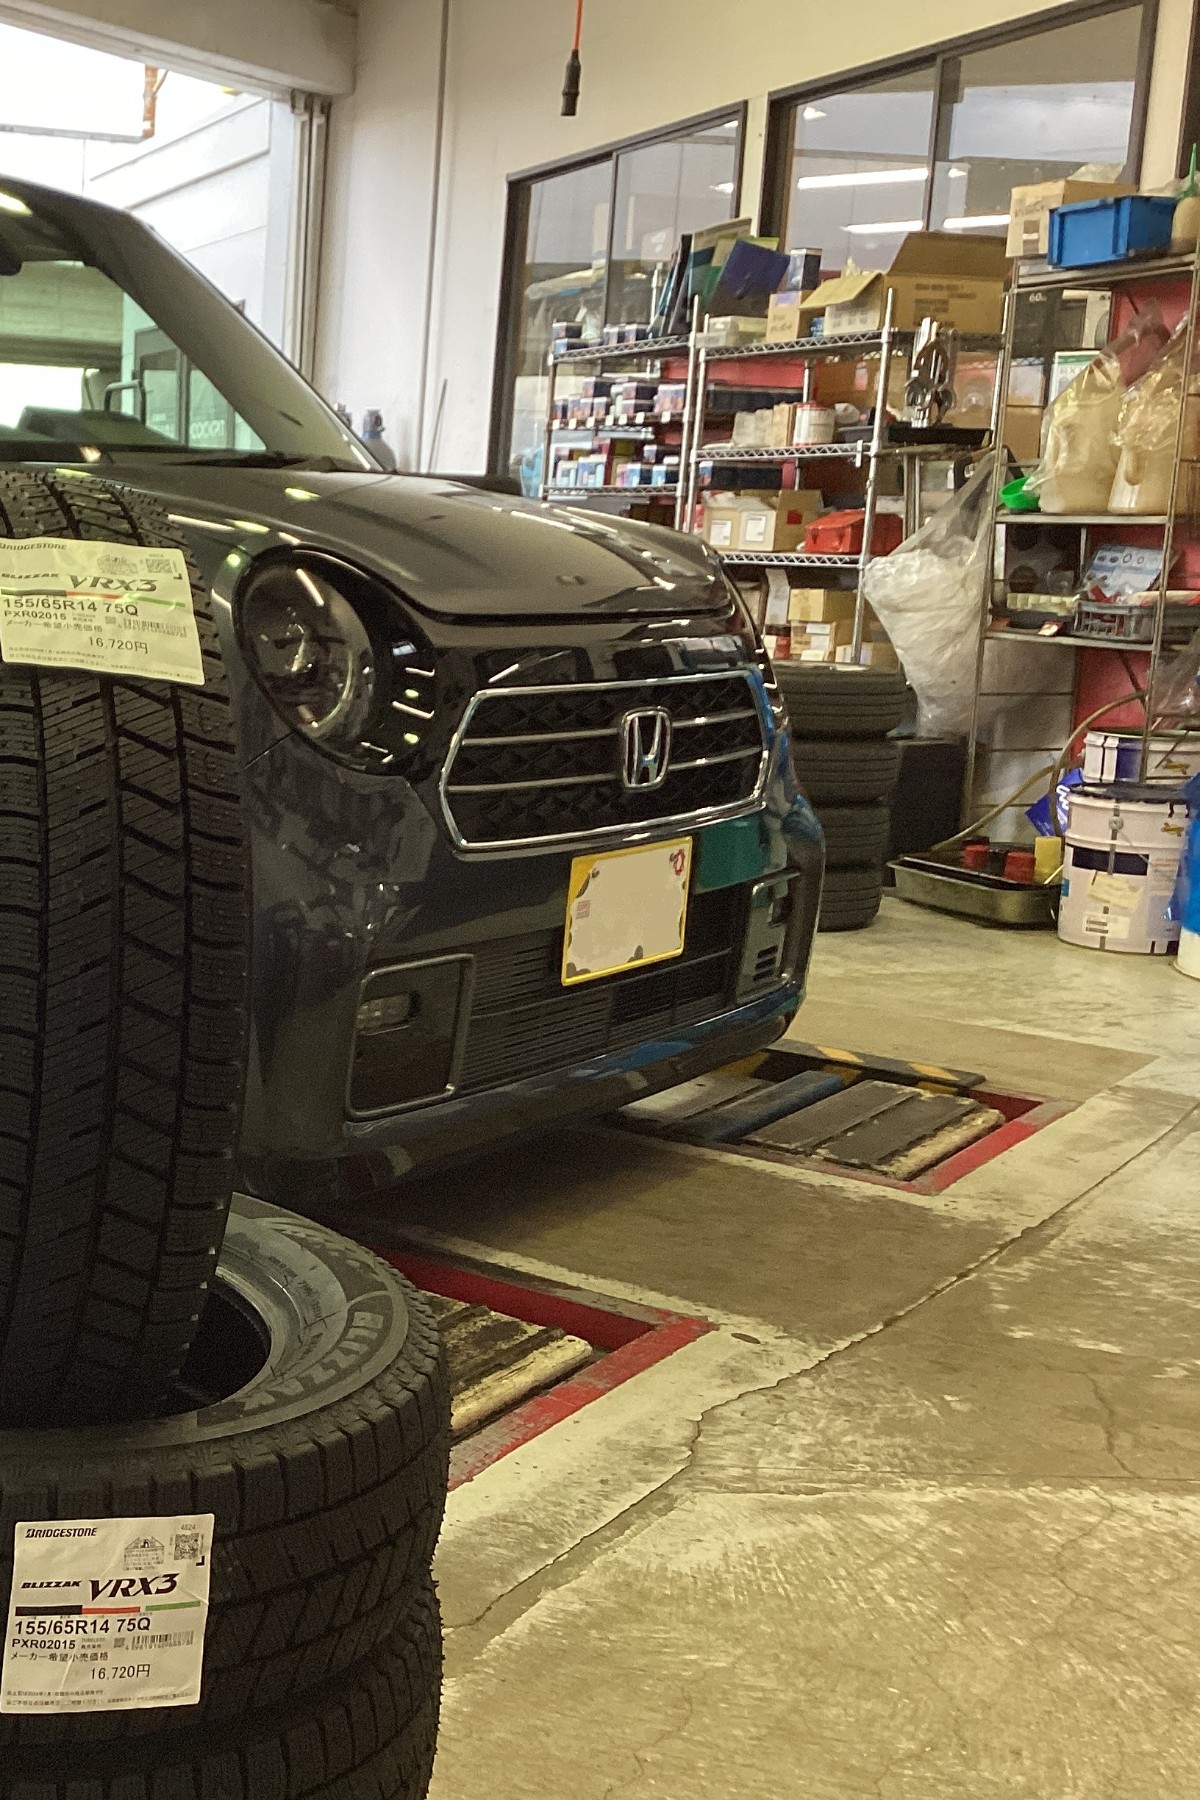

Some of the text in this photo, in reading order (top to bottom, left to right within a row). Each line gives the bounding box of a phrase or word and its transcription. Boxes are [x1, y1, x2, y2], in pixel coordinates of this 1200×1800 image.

[67, 574, 158, 593] VRX3
[3, 598, 139, 617] 155/65R14 75Q
[4, 610, 67, 620] PXR02015
[6, 619, 103, 633] メーカー希望小売価格
[89, 636, 149, 654] 16,720円
[25, 1527, 98, 1539] BRIDGESTONE
[21, 1572, 180, 1601] BLIZZAK VRX3
[15, 1616, 152, 1635] 155/65R14 75Q
[11, 1639, 76, 1650] PXR02015
[10, 1651, 109, 1663] メーカー希望小売価格
[90, 1663, 151, 1681] 16,720円
